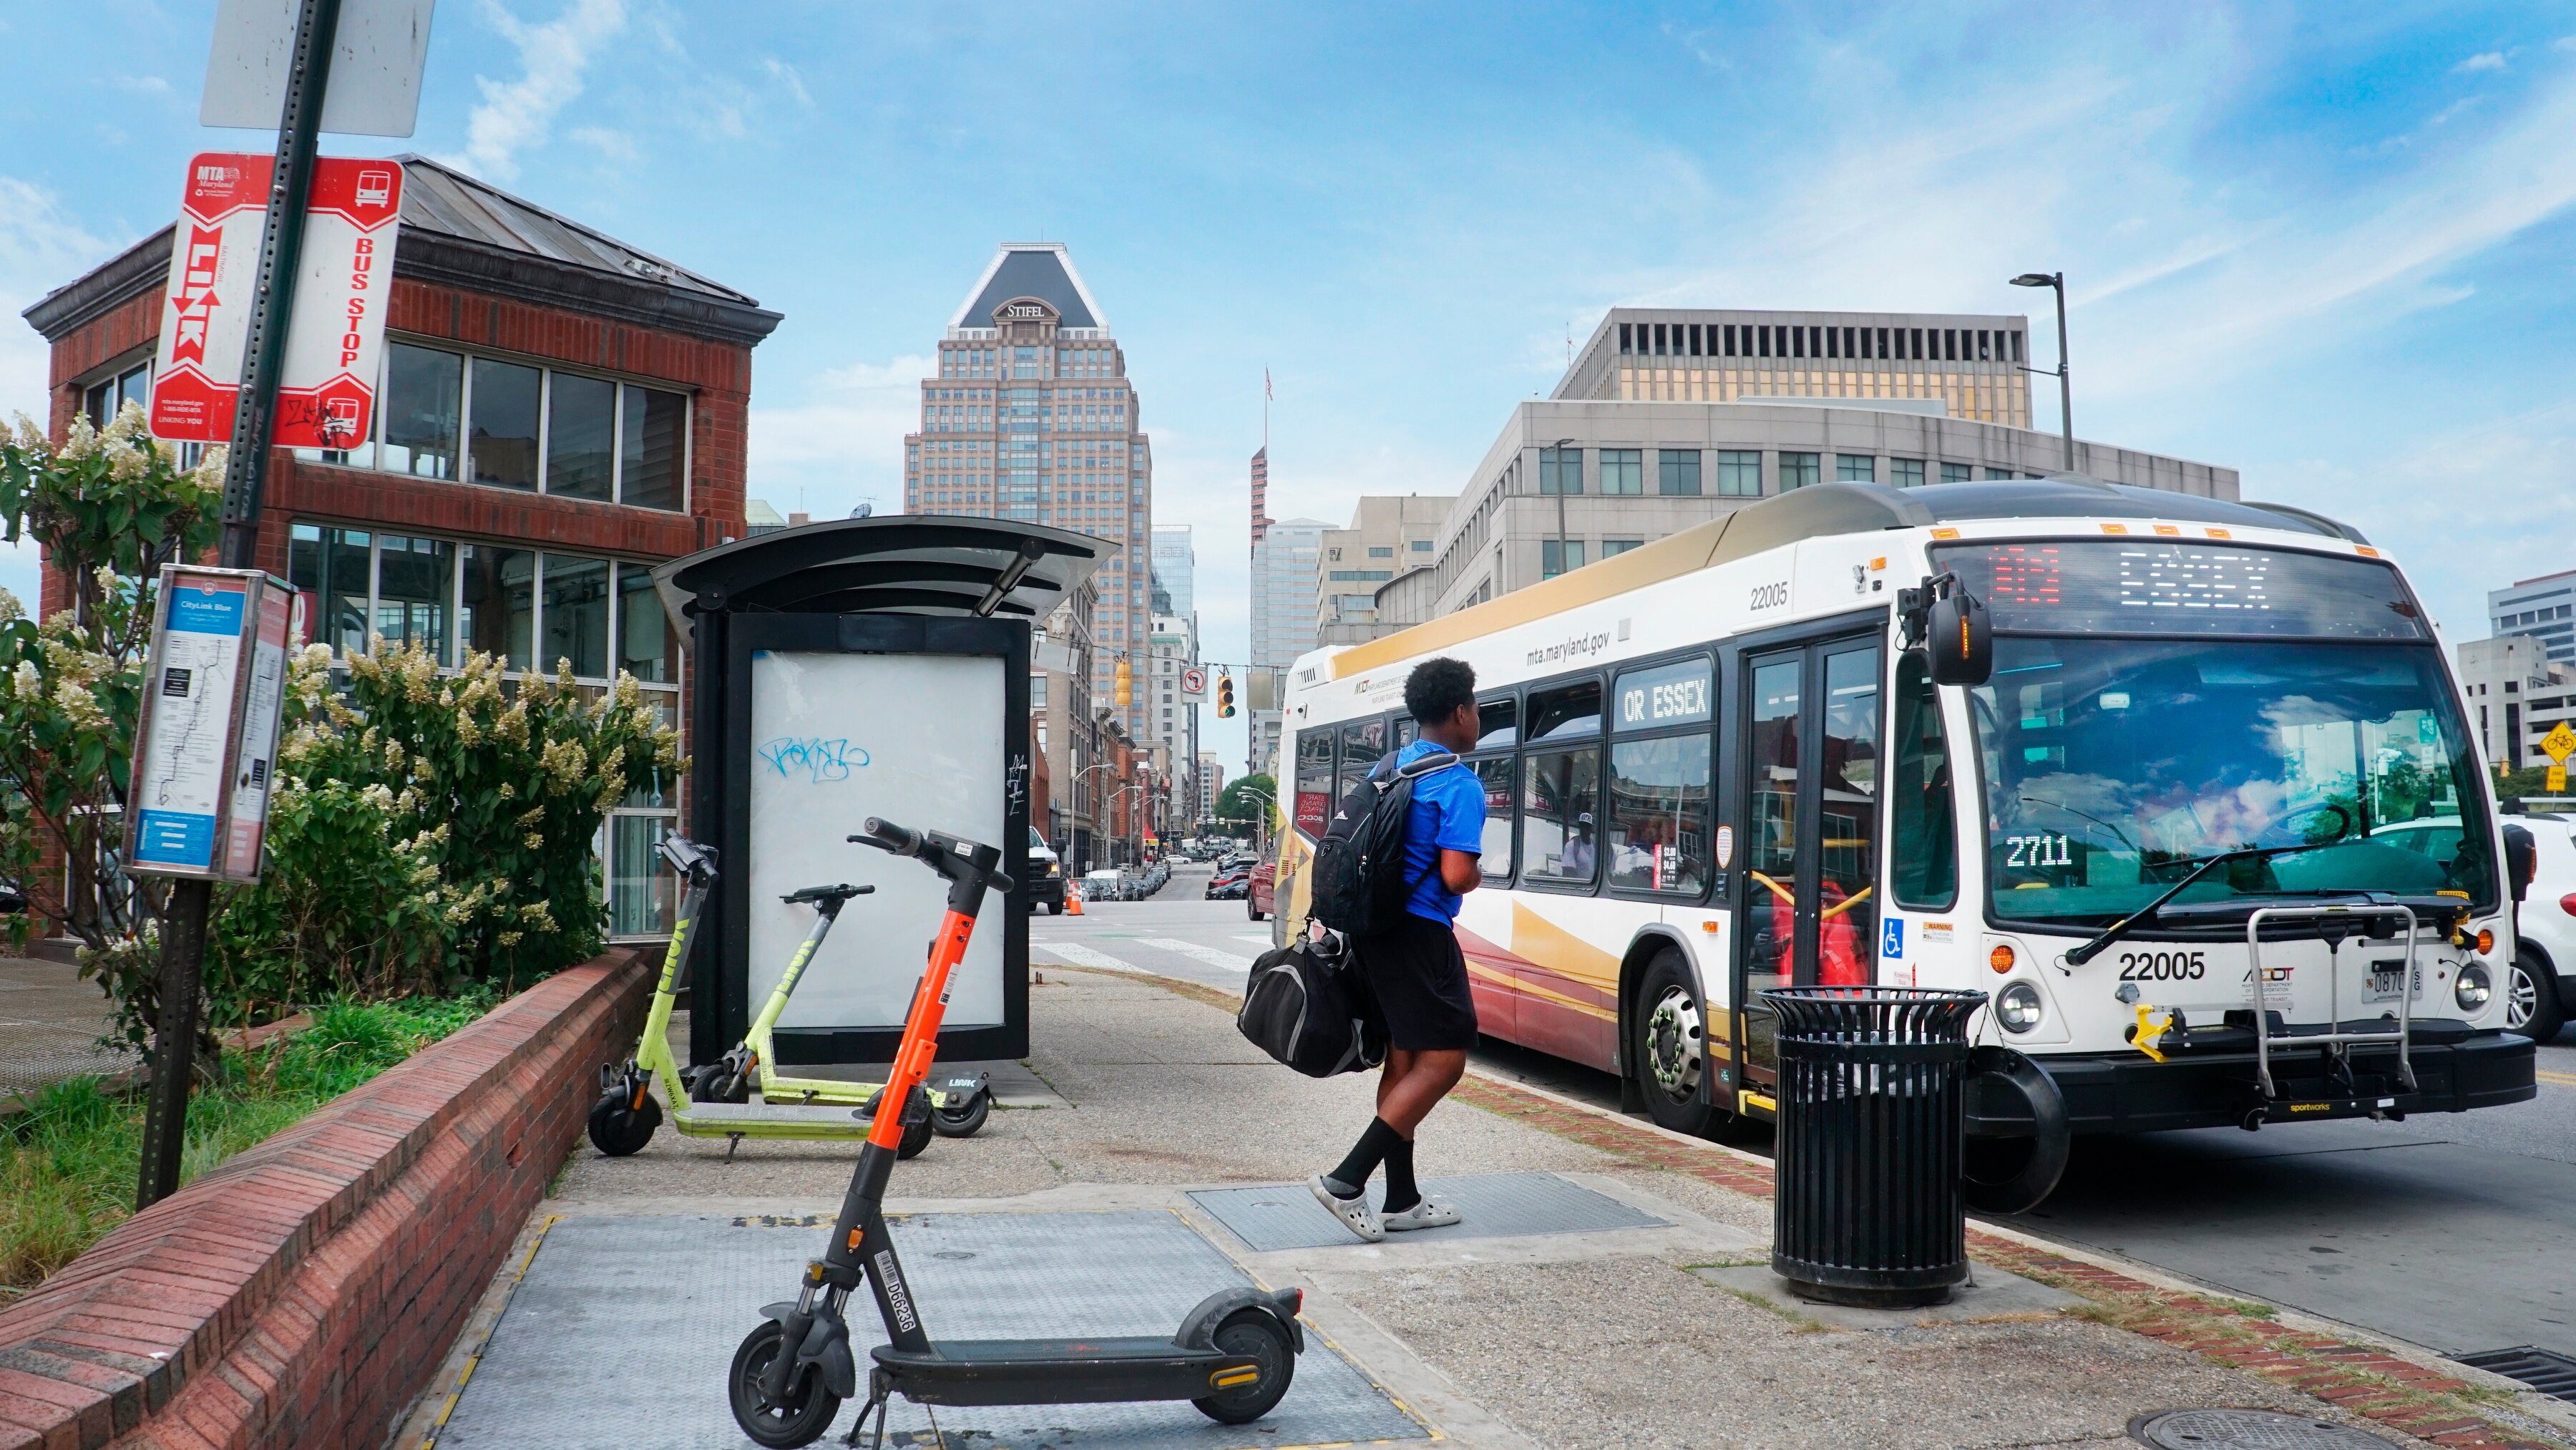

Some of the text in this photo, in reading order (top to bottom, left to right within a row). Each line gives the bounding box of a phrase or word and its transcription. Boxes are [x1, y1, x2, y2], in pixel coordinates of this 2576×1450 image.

[197, 166, 223, 180] MTA
[217, 245, 228, 283] BALTIMORE
[177, 244, 217, 349] LINK
[341, 238, 374, 367] BUS STOP
[1008, 305, 1045, 317] STIFEL
[180, 600, 233, 612] CityLink Blue
[1750, 581, 1787, 610] 22005
[1527, 632, 1609, 666] mta.maryland.gov
[1624, 679, 1707, 722] OR ESSEX
[2007, 835, 2072, 867] 2711
[2119, 952, 2205, 981] 22005
[949, 1079, 976, 1087] LINK
[2290, 1103, 2330, 1112] sportworks
[888, 1283, 914, 1330] D66236
